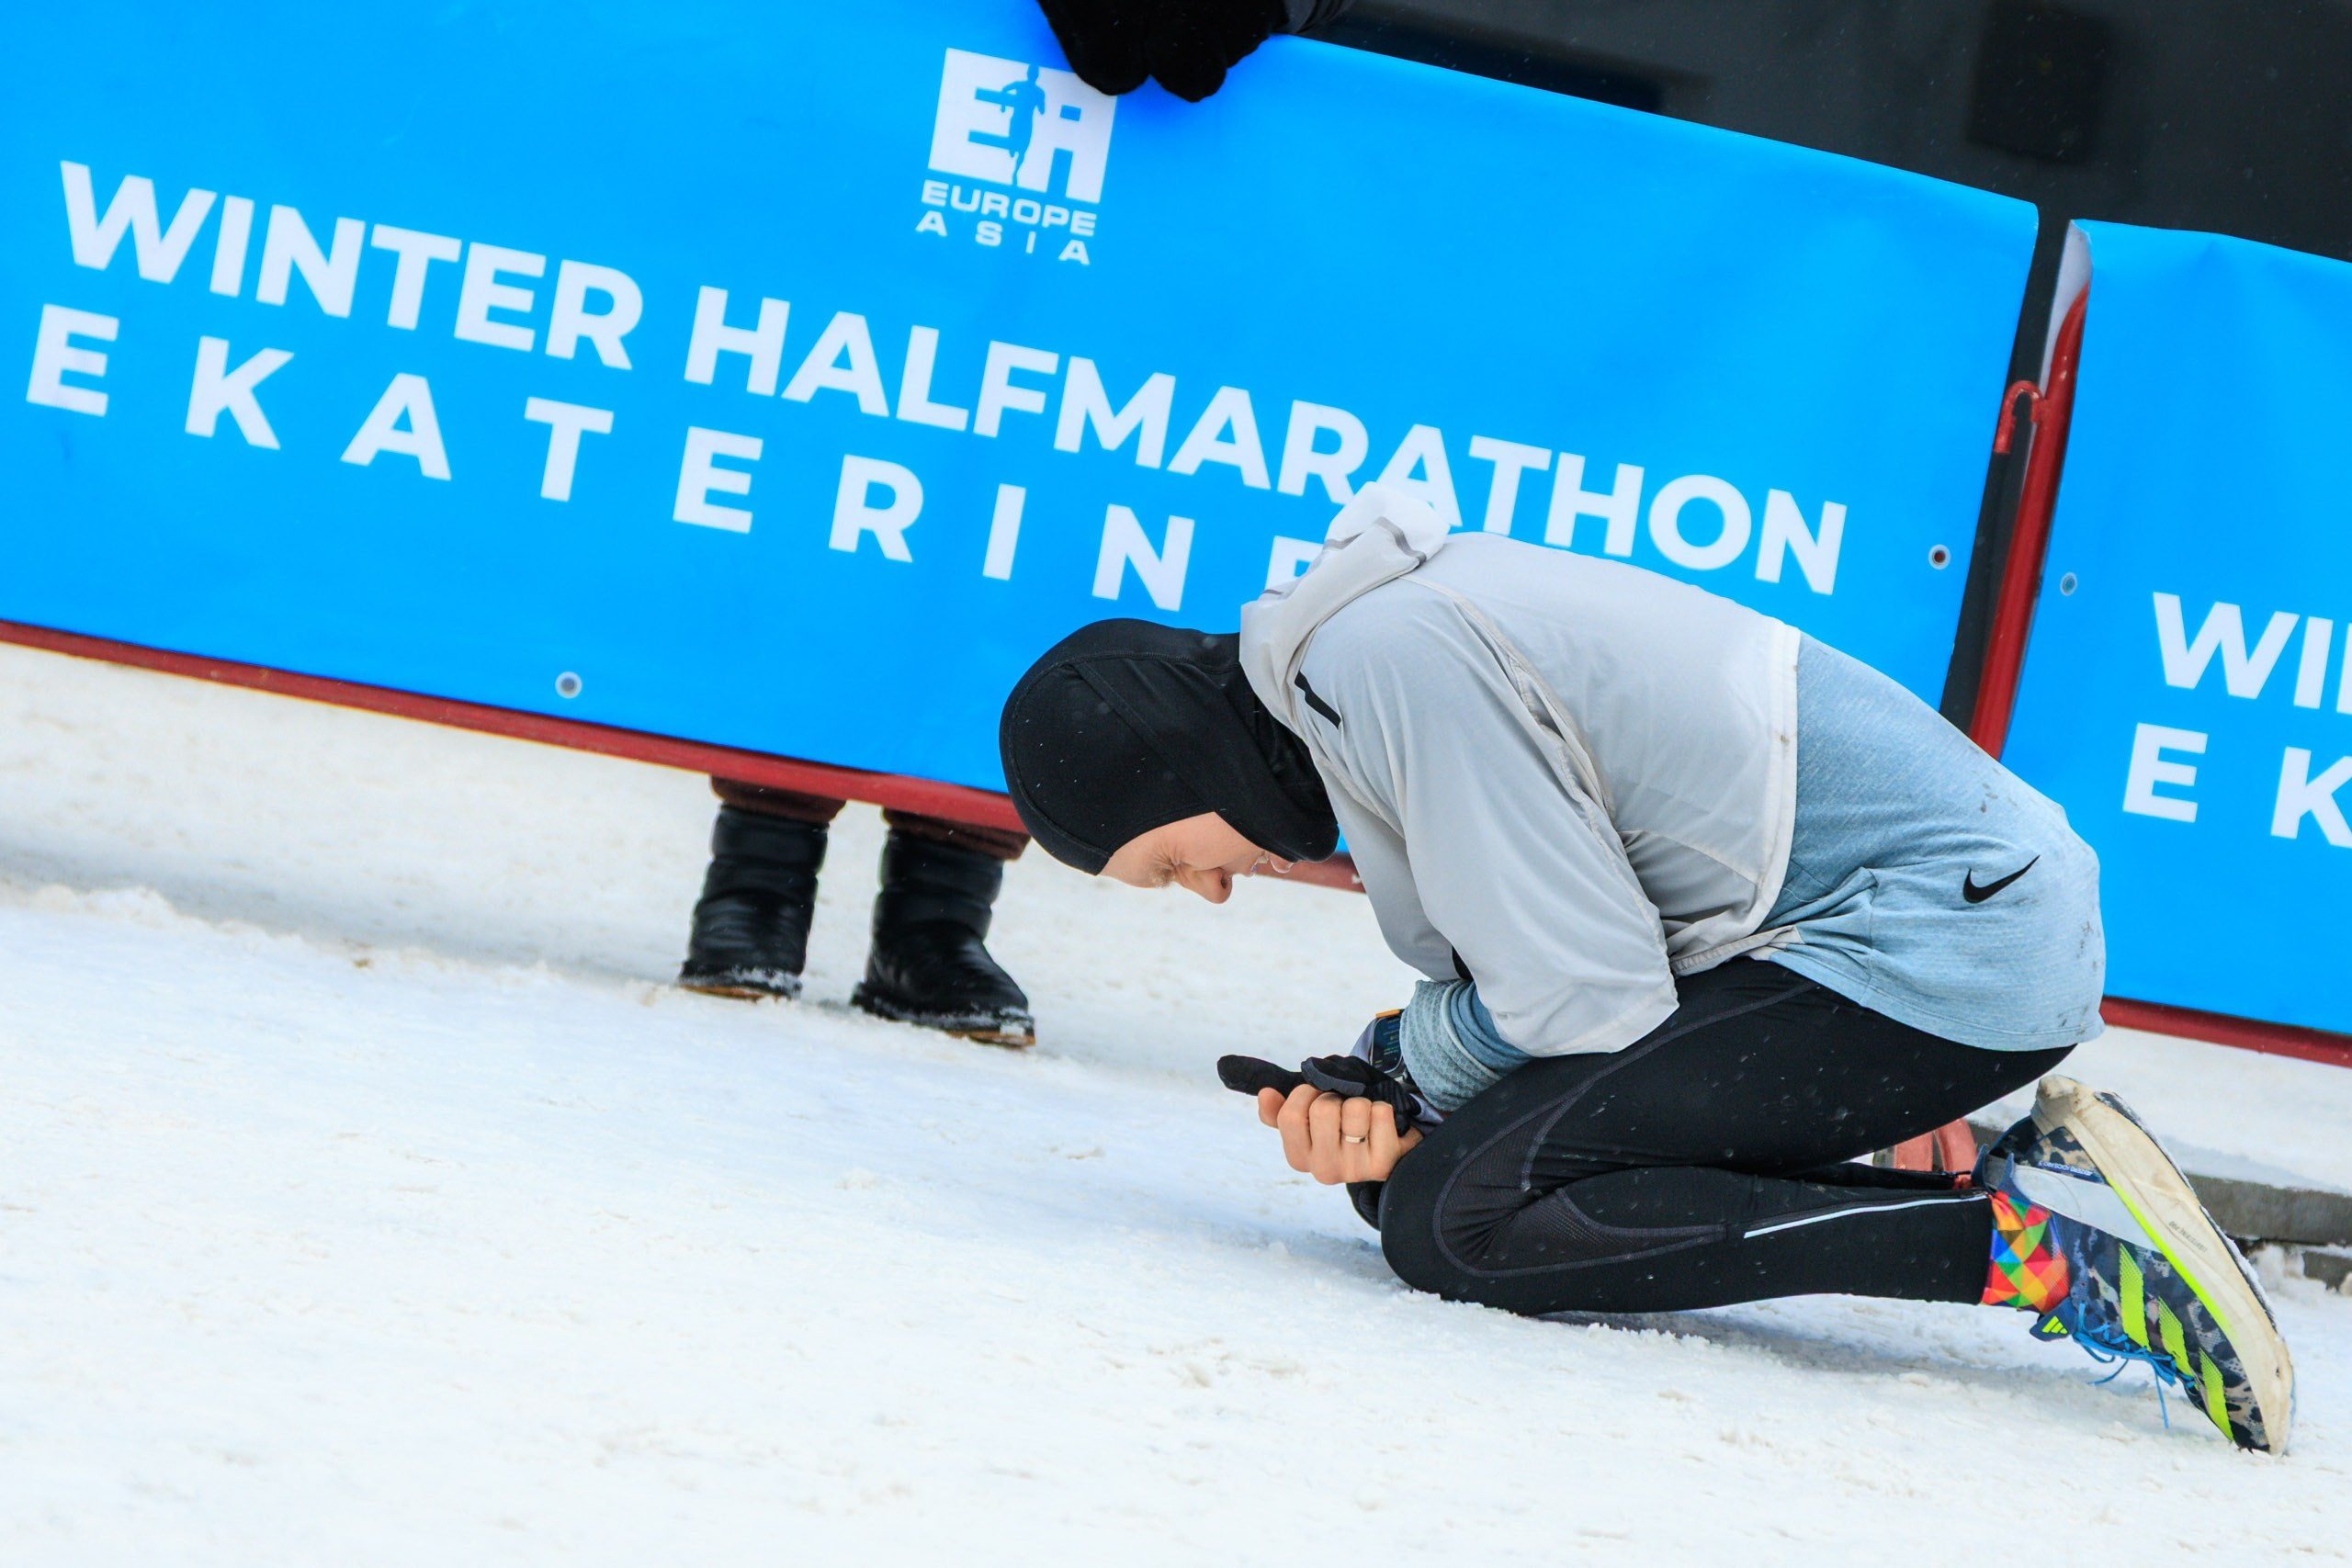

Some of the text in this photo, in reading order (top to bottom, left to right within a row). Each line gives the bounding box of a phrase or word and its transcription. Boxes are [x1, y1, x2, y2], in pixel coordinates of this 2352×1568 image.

[915, 210, 1091, 265] ASIA
[922, 179, 1097, 236] EUROPE
[61, 160, 1847, 595] WINTER HALFMARATHON
[2153, 592, 2352, 715] WI
